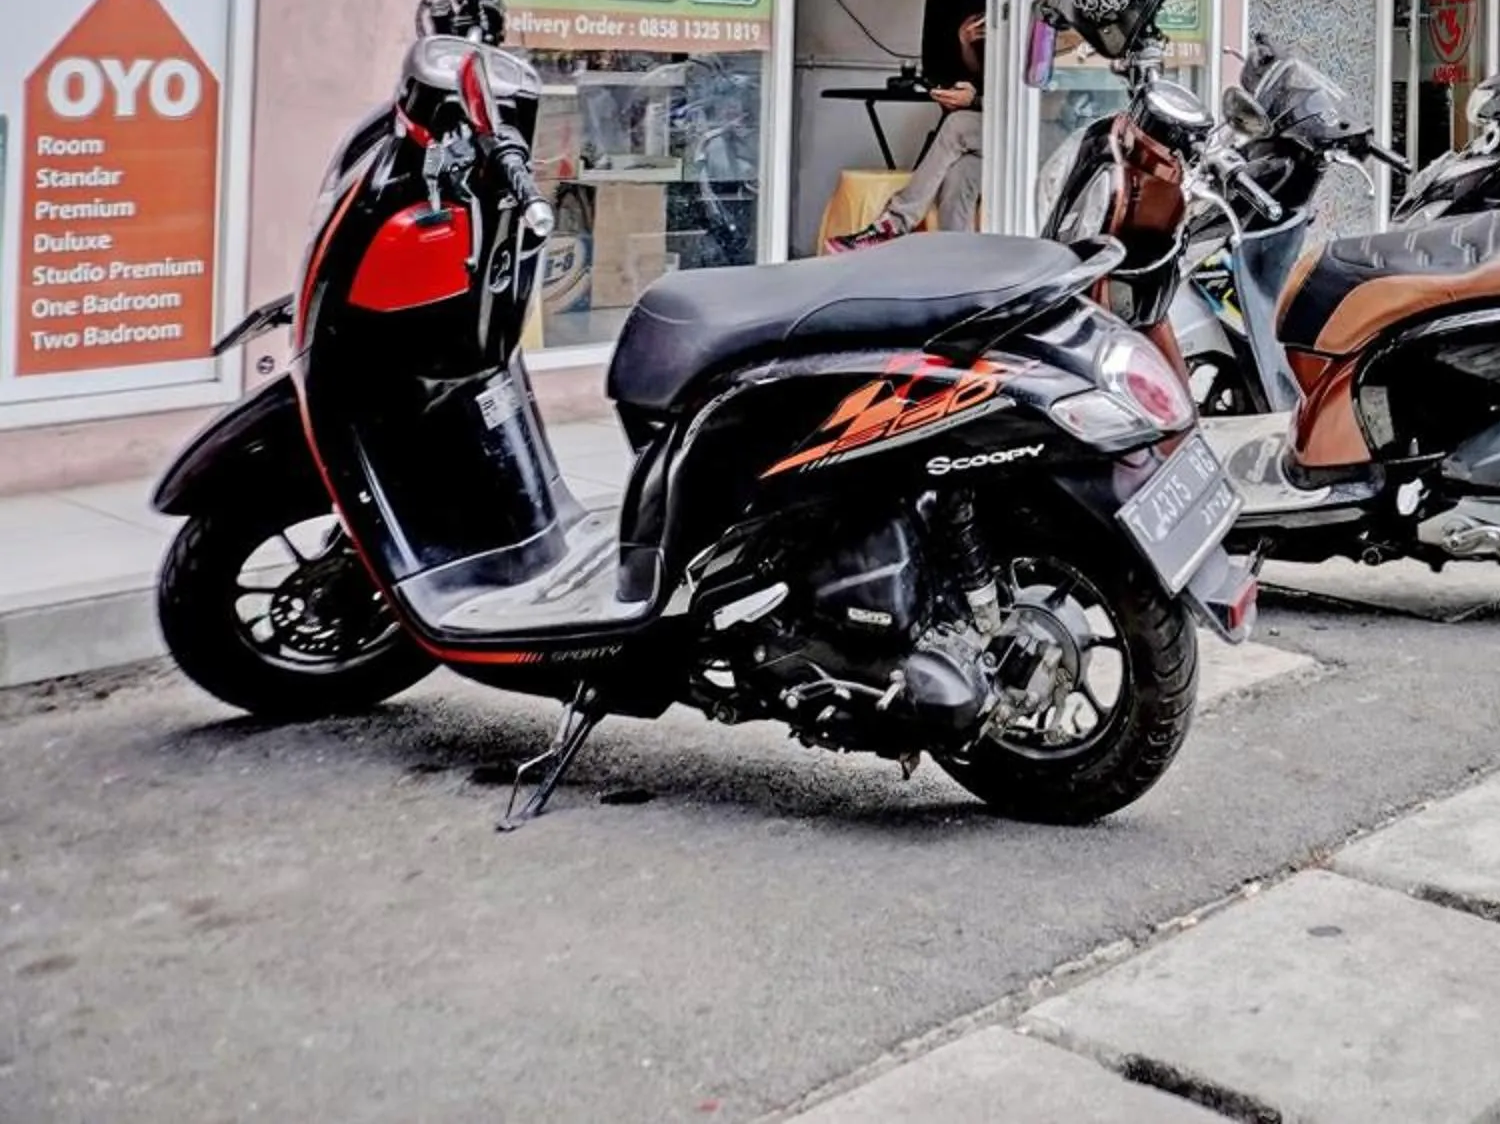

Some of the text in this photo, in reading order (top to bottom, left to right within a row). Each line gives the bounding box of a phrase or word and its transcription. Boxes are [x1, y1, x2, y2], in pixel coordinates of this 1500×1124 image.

[575, 16, 623, 36] Order
[639, 18, 679, 38] 0858
[685, 19, 720, 39] 1325
[726, 22, 760, 42] 1819
[47, 57, 202, 118] OYO
[37, 135, 105, 157] Room
[36, 166, 124, 189] Standar
[35, 199, 135, 220] Premium
[33, 231, 113, 253] Duluxe
[32, 257, 204, 286] Studio Premium
[32, 292, 181, 318] One Badroom
[30, 322, 182, 351] Two Badroom
